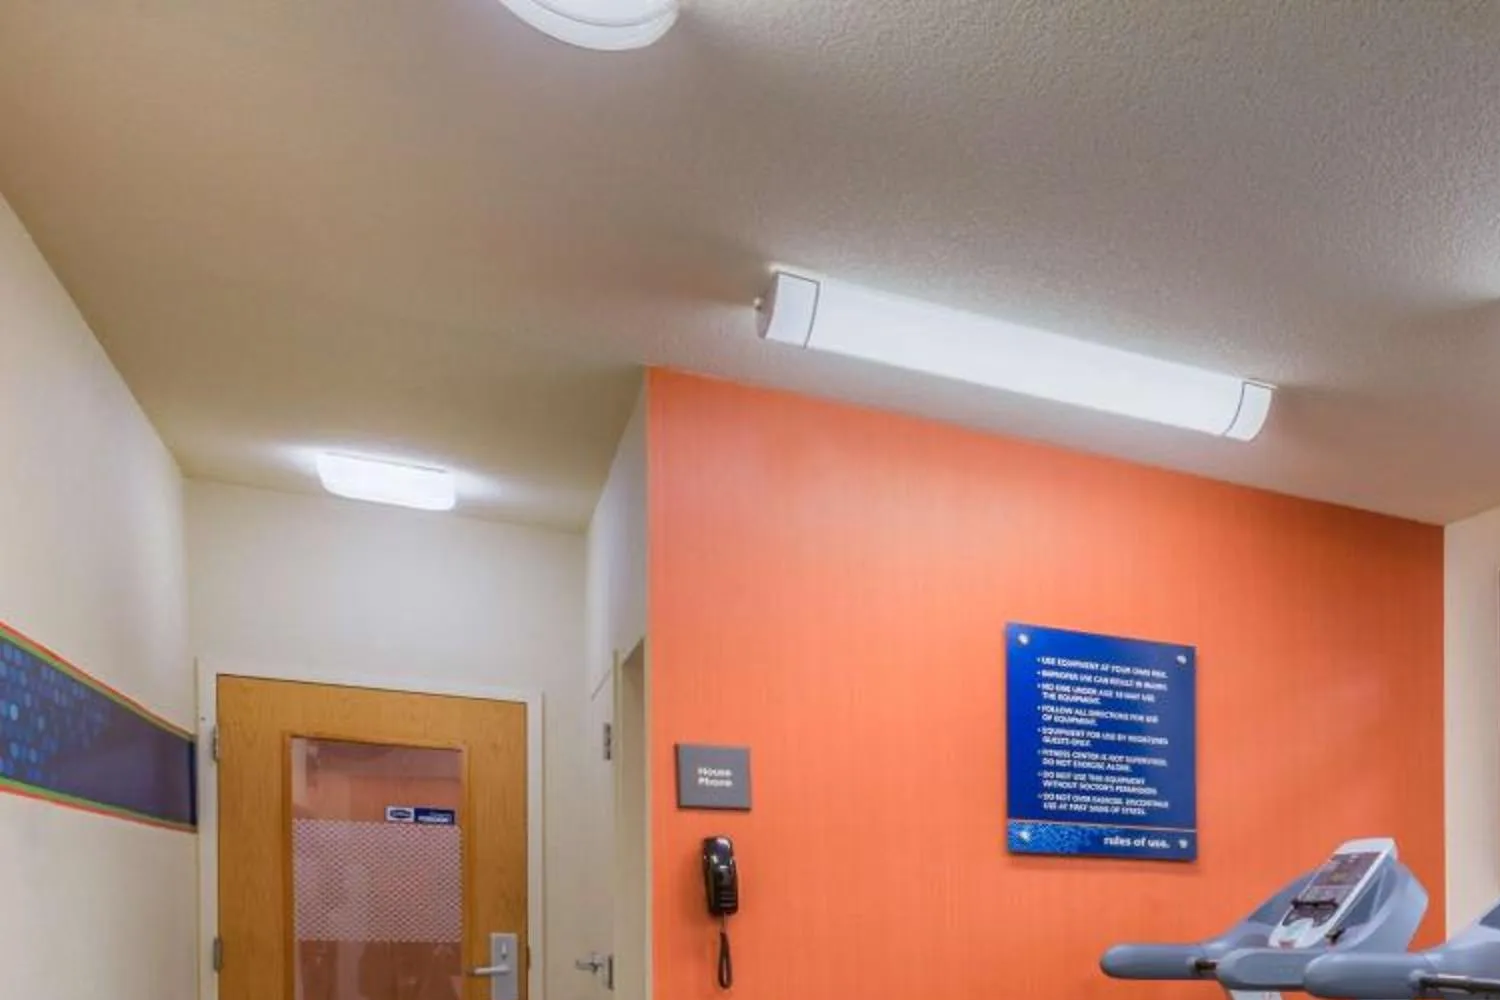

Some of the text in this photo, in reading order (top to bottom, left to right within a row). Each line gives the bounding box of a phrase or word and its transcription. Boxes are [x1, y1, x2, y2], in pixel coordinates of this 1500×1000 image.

[1103, 835, 1171, 849] rules of use.
